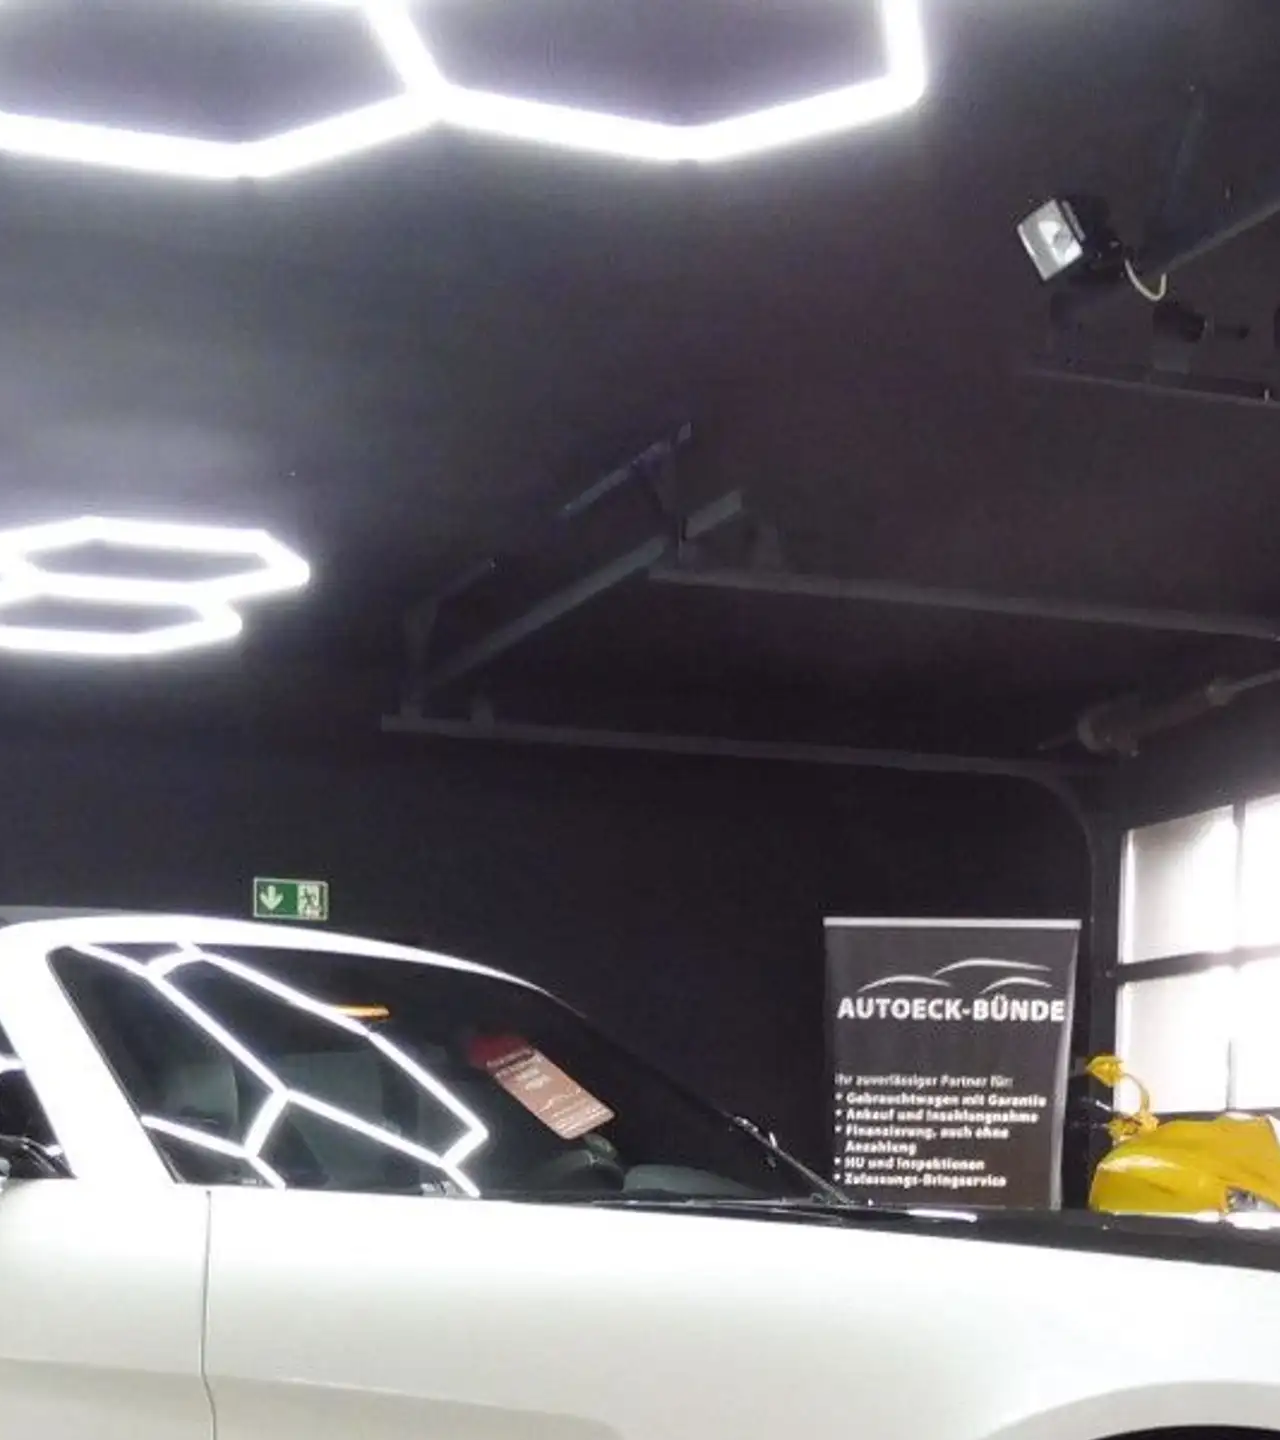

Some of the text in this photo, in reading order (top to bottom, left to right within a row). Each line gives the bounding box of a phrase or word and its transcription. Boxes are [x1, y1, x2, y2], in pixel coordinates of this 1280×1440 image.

[836, 995, 1066, 1023] AUTOECK-BÜNDE
[940, 1074, 987, 1088] Partner
[846, 1092, 1048, 1108] Gebrauchtwagen mit Garantie
[846, 1109, 894, 1122] Ankauf
[896, 1109, 923, 1122] und
[845, 1125, 1010, 1140] Finanzierung, auch ohne
[844, 1140, 918, 1156] Anzahlung
[844, 1157, 986, 1172] HU und Inspektionen
[843, 1172, 1008, 1189] Zulassungs-Bringservice
